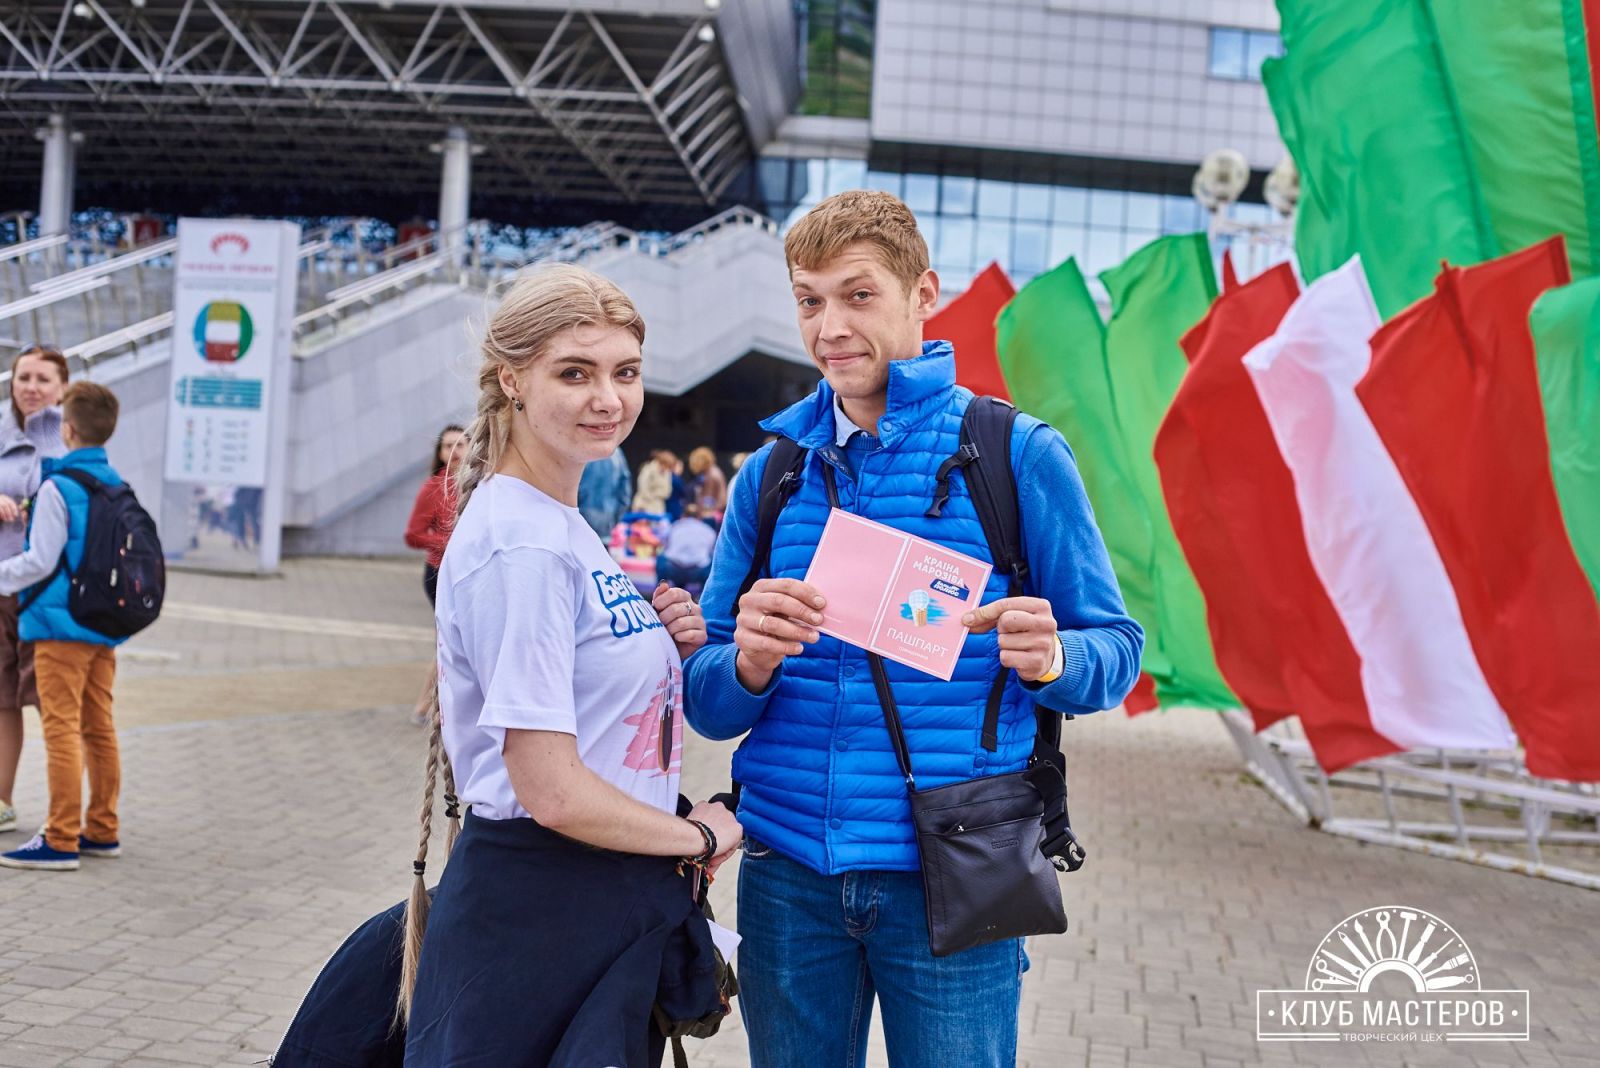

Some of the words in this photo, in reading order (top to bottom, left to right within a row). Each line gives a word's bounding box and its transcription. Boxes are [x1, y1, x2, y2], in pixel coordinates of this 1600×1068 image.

[912, 560, 965, 587] МАРОЗІВА
[923, 555, 960, 576] КРАІНА
[886, 627, 949, 657] ПАШПАРТ
